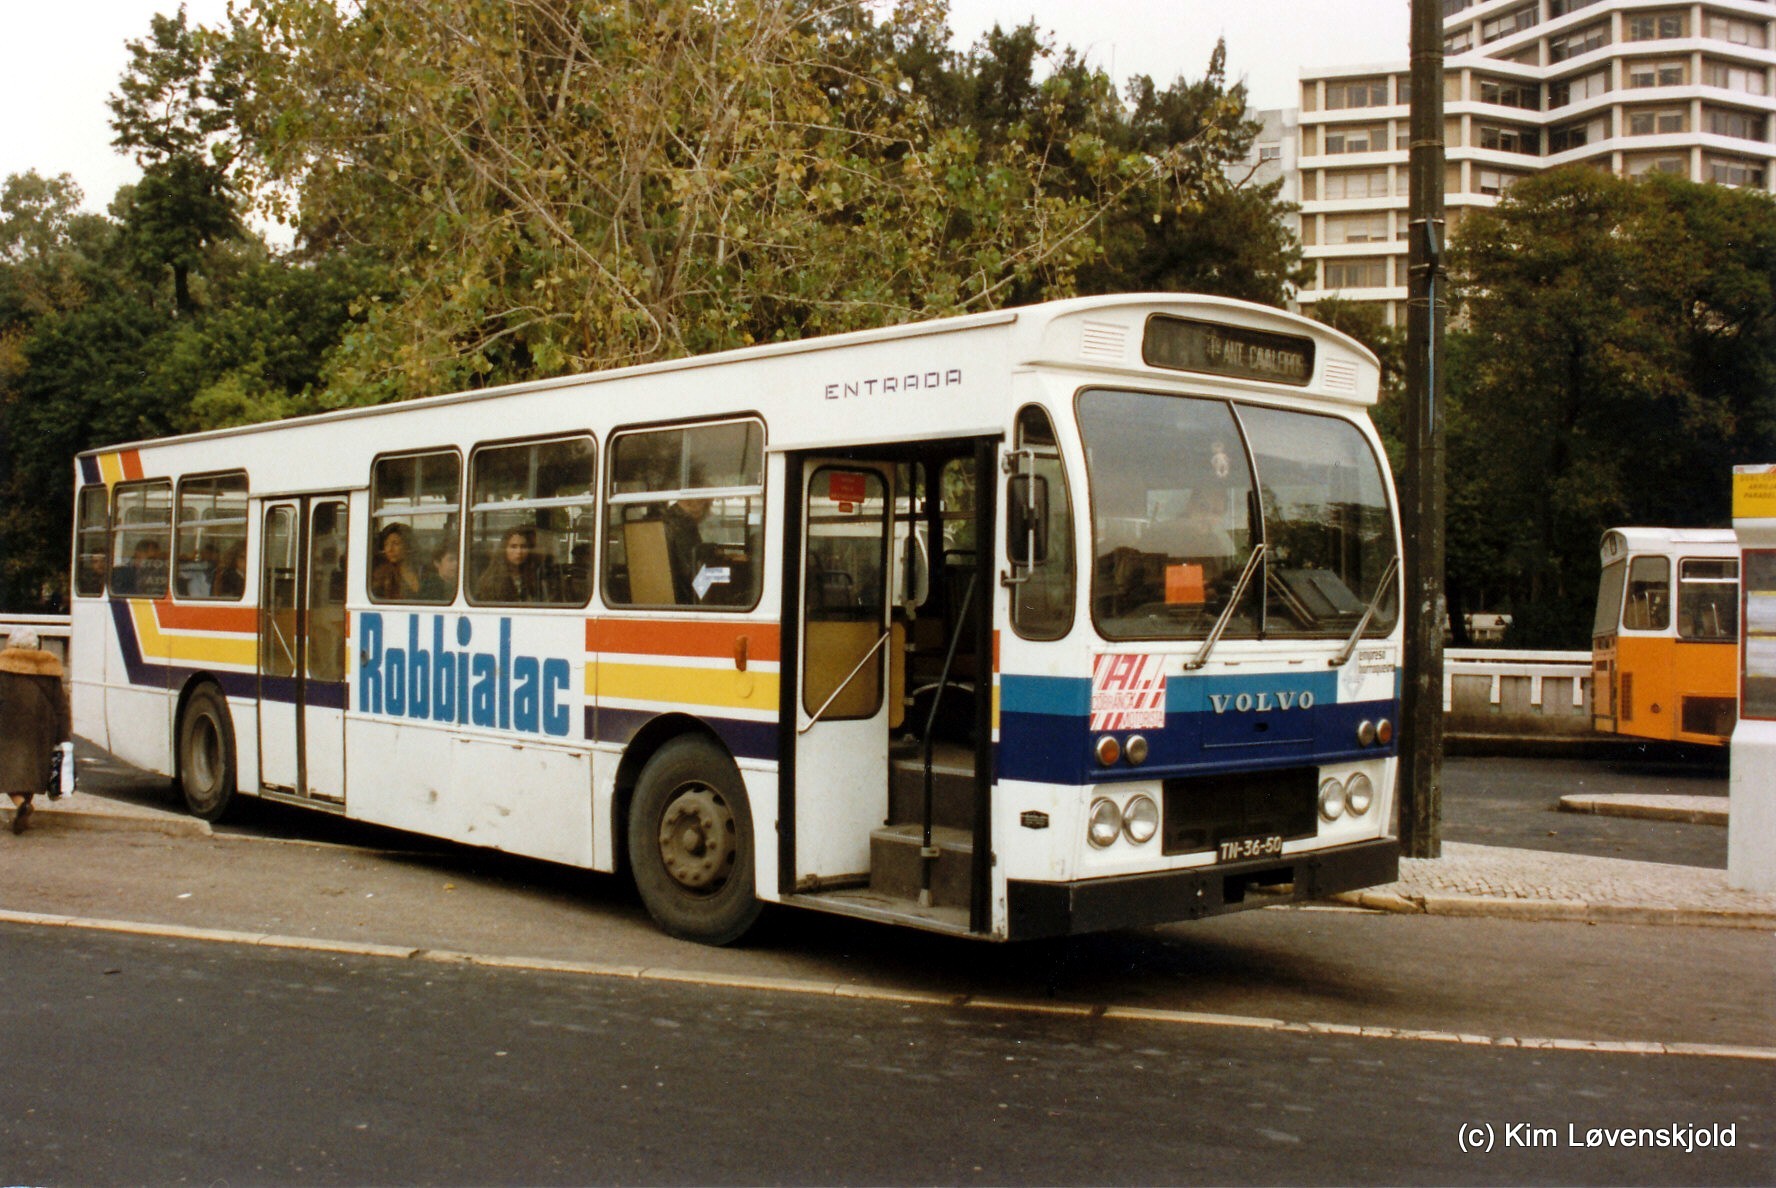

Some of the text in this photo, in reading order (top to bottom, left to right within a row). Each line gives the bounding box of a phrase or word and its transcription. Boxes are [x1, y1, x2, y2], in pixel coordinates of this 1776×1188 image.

[825, 369, 961, 400] ENTRADA
[359, 612, 570, 736] Robbialac
[1208, 691, 1314, 714] VOLVO
